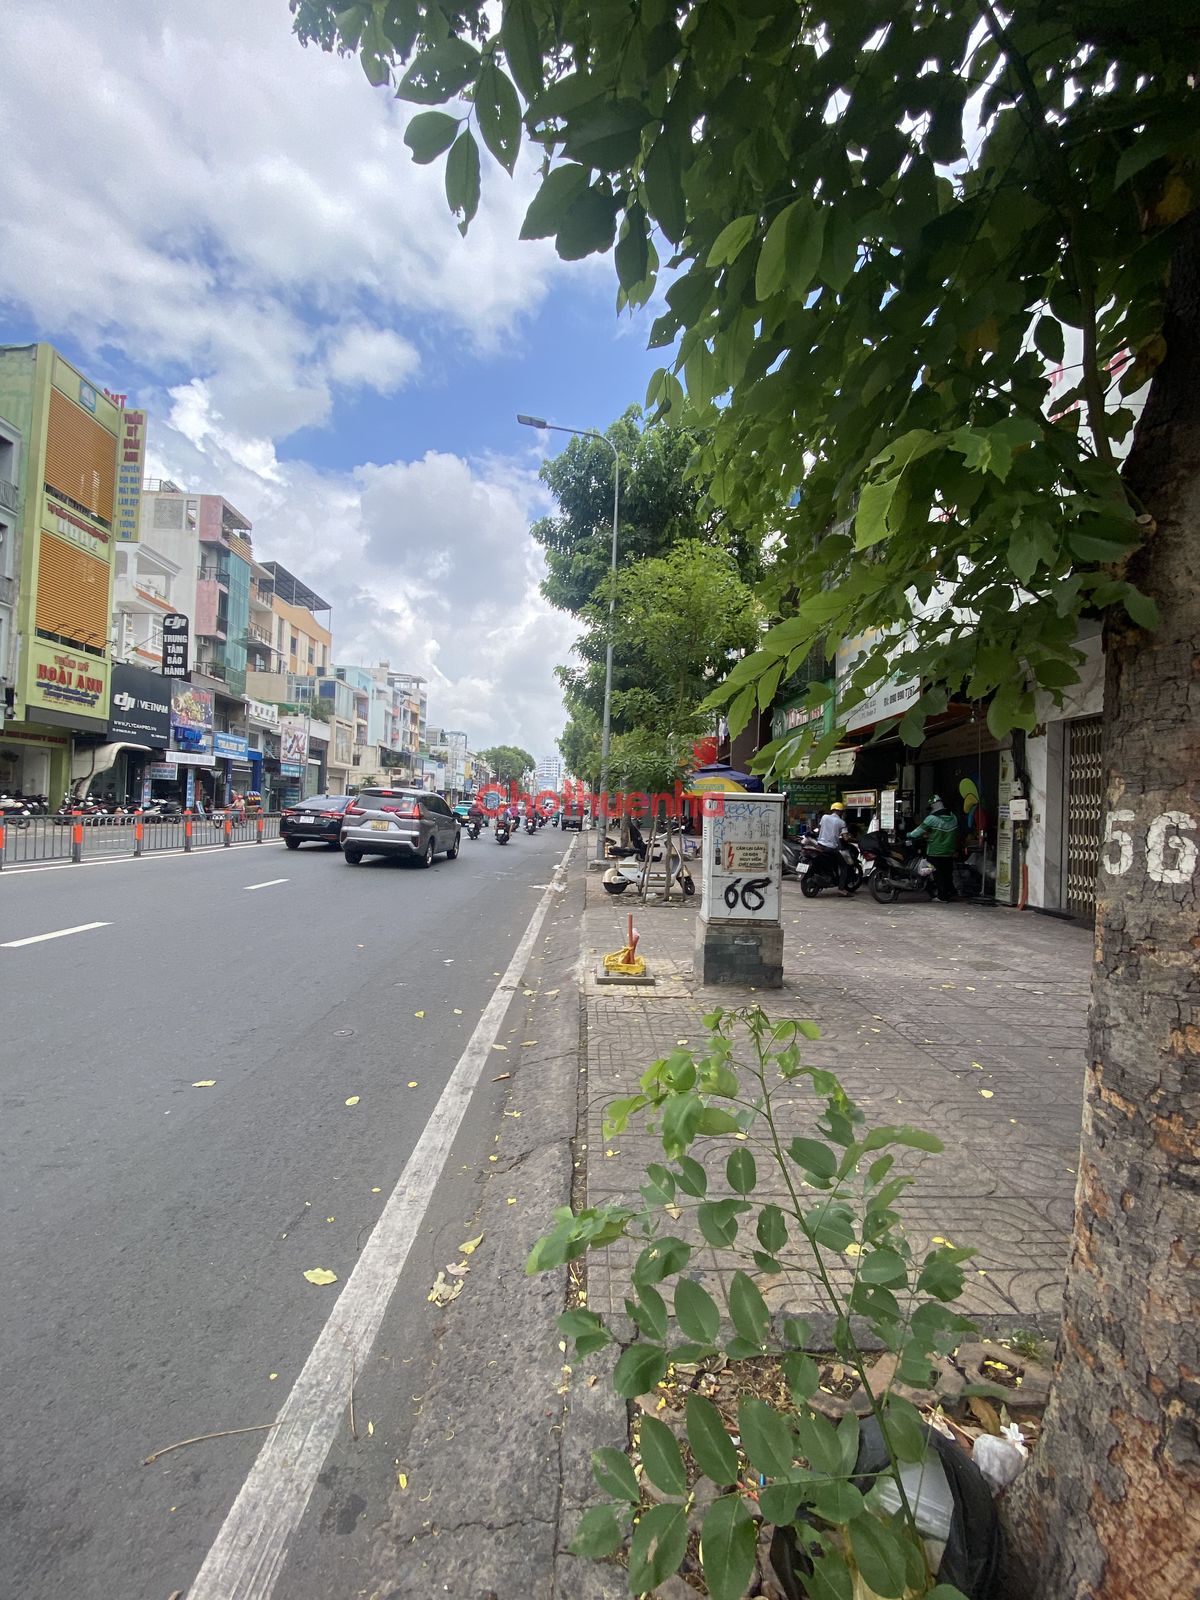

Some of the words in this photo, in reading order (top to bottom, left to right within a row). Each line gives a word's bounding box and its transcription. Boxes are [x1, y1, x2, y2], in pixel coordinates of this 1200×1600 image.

[163, 634, 188, 643] TRUNG
[167, 644, 184, 654] TÂM
[167, 654, 183, 665] BẢO
[164, 665, 185, 676] HÀNH
[37, 663, 73, 686] HOÀI
[76, 674, 103, 694] ANH
[140, 700, 168, 714] VIETNAM
[1103, 809, 1199, 883] 56
